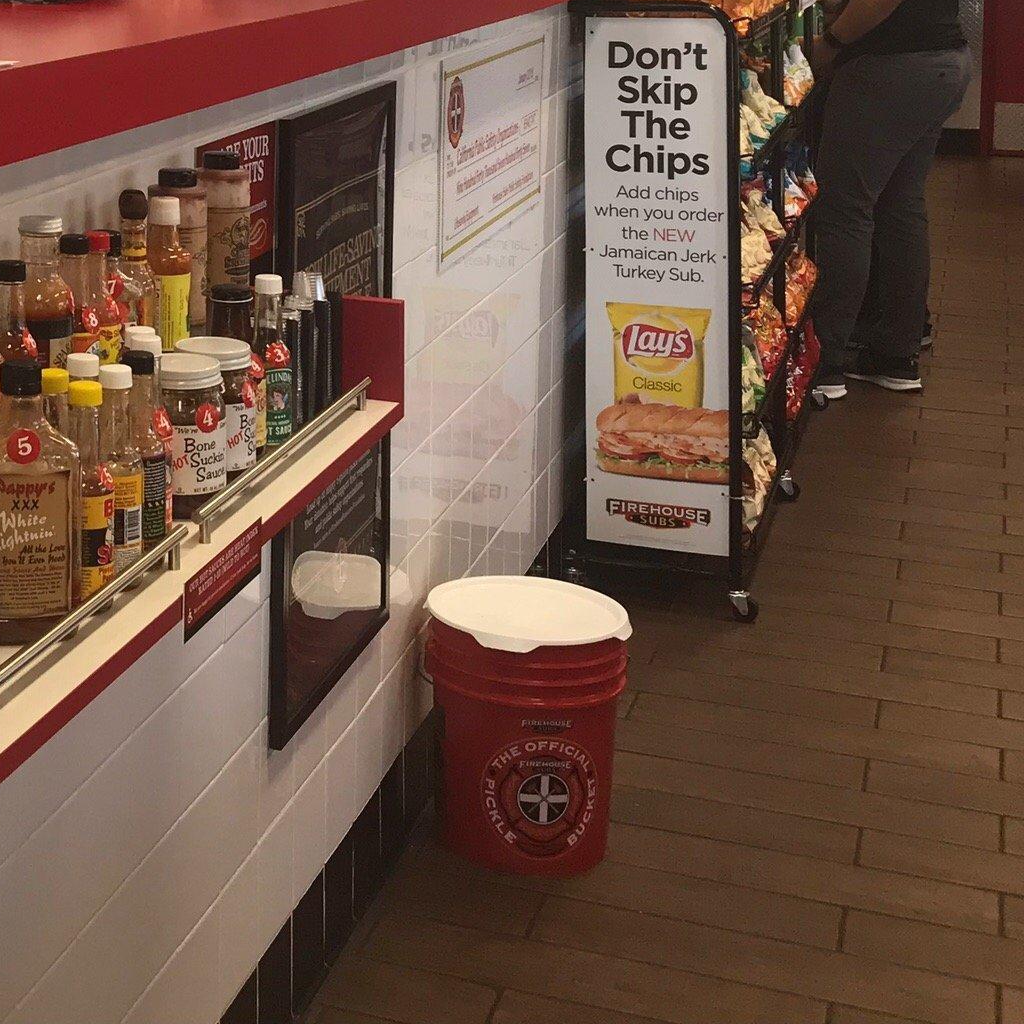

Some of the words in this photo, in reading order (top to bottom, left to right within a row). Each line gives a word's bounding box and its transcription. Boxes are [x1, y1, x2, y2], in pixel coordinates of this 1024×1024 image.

[607, 40, 708, 71] Don't
[617, 75, 698, 111] Skip
[620, 109, 691, 140] The
[242, 134, 269, 162] YOUR
[605, 144, 710, 180] Chips
[616, 184, 651, 200] Add
[655, 186, 699, 204] chips
[594, 204, 639, 218] when
[643, 207, 673, 222] you
[678, 207, 725, 222] order
[621, 226, 649, 241] the
[653, 228, 696, 243] NEW
[599, 244, 677, 262] Jamaican
[680, 248, 717, 264] Jerk
[613, 263, 666, 283] Turkey
[669, 267, 704, 283] Sub.
[627, 324, 689, 358] Lay's
[632, 376, 683, 393] Classic
[17, 436, 33, 456] 5
[184, 437, 217, 453] Bone
[227, 430, 244, 449] HOT
[196, 466, 225, 483] Sauce
[11, 499, 40, 511] XXX
[608, 498, 710, 526] FIREHOUSE
[639, 514, 676, 528] SUBS
[209, 555, 225, 576] SAUCES
[521, 719, 572, 728] FIREHOUSE
[491, 745, 522, 770] THE
[524, 741, 590, 773] OFFICIAL
[519, 760, 572, 769] FIREHOUSE
[484, 777, 517, 845] PICKLE
[566, 778, 597, 847] BUCKET
